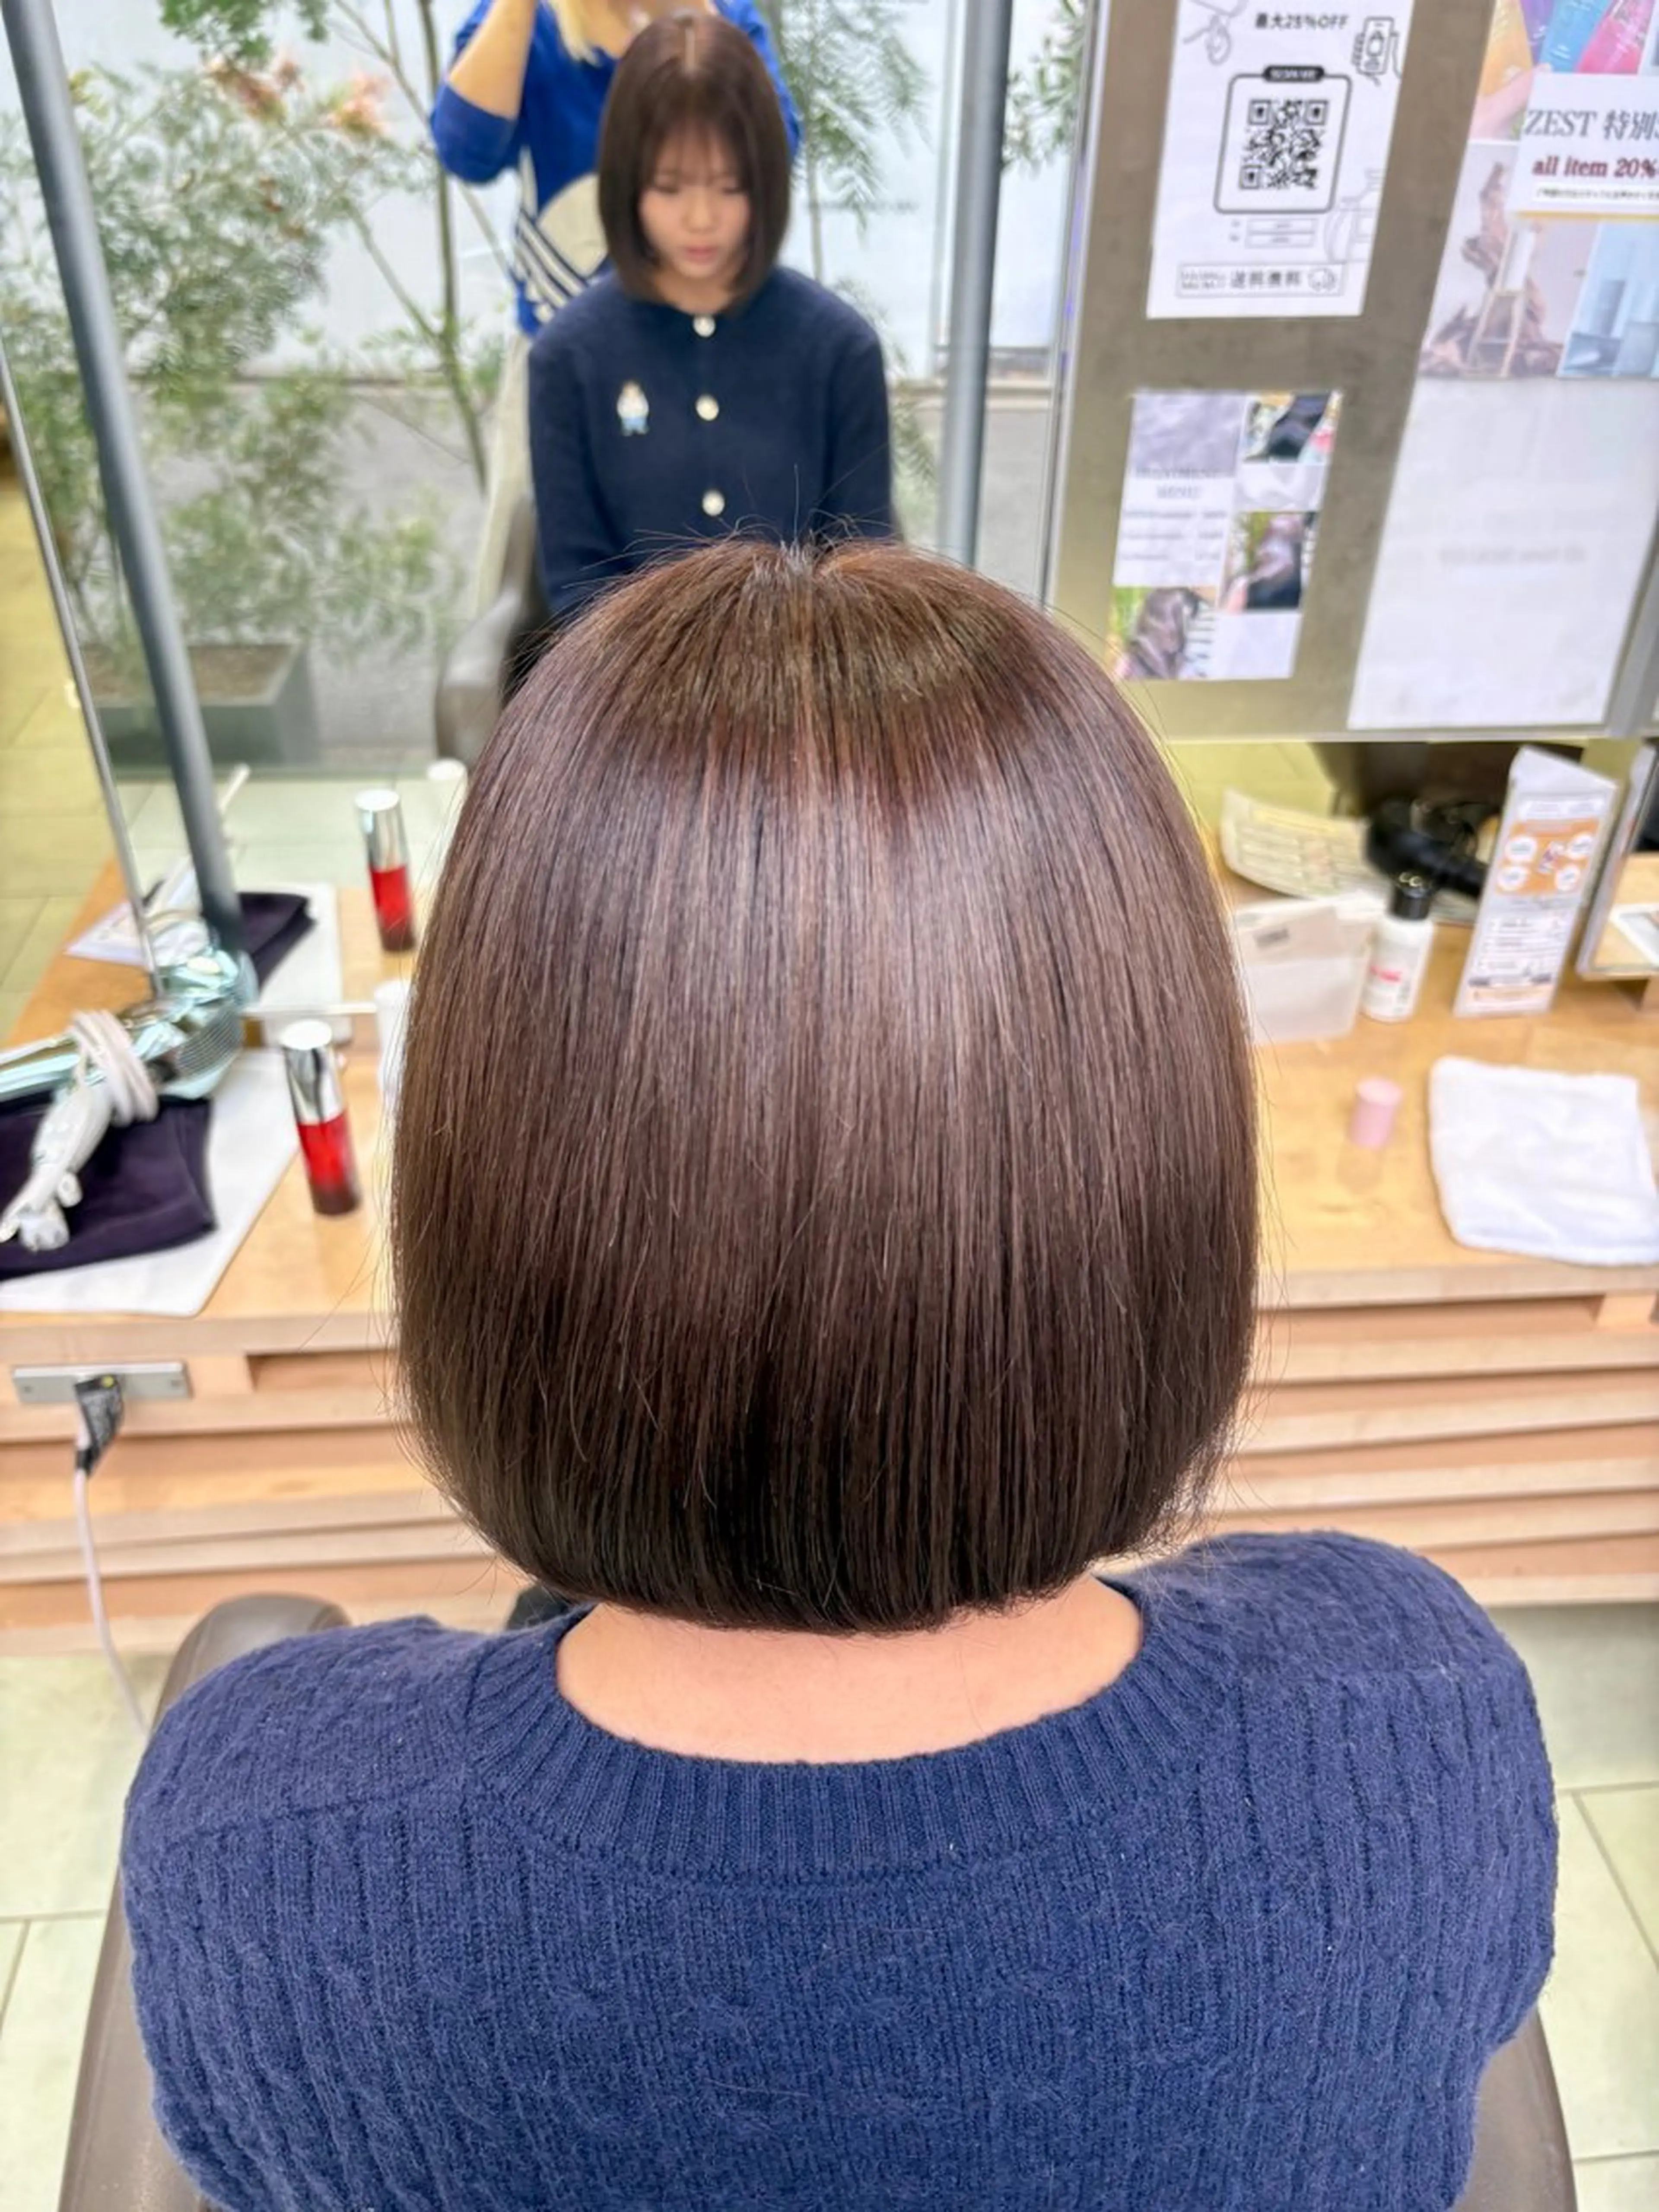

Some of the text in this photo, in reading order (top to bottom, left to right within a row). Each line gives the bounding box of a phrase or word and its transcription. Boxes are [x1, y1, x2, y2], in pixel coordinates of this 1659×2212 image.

[1525, 110, 1659, 140] ZEST 特別
[1533, 156, 1659, 178] all item 20%
